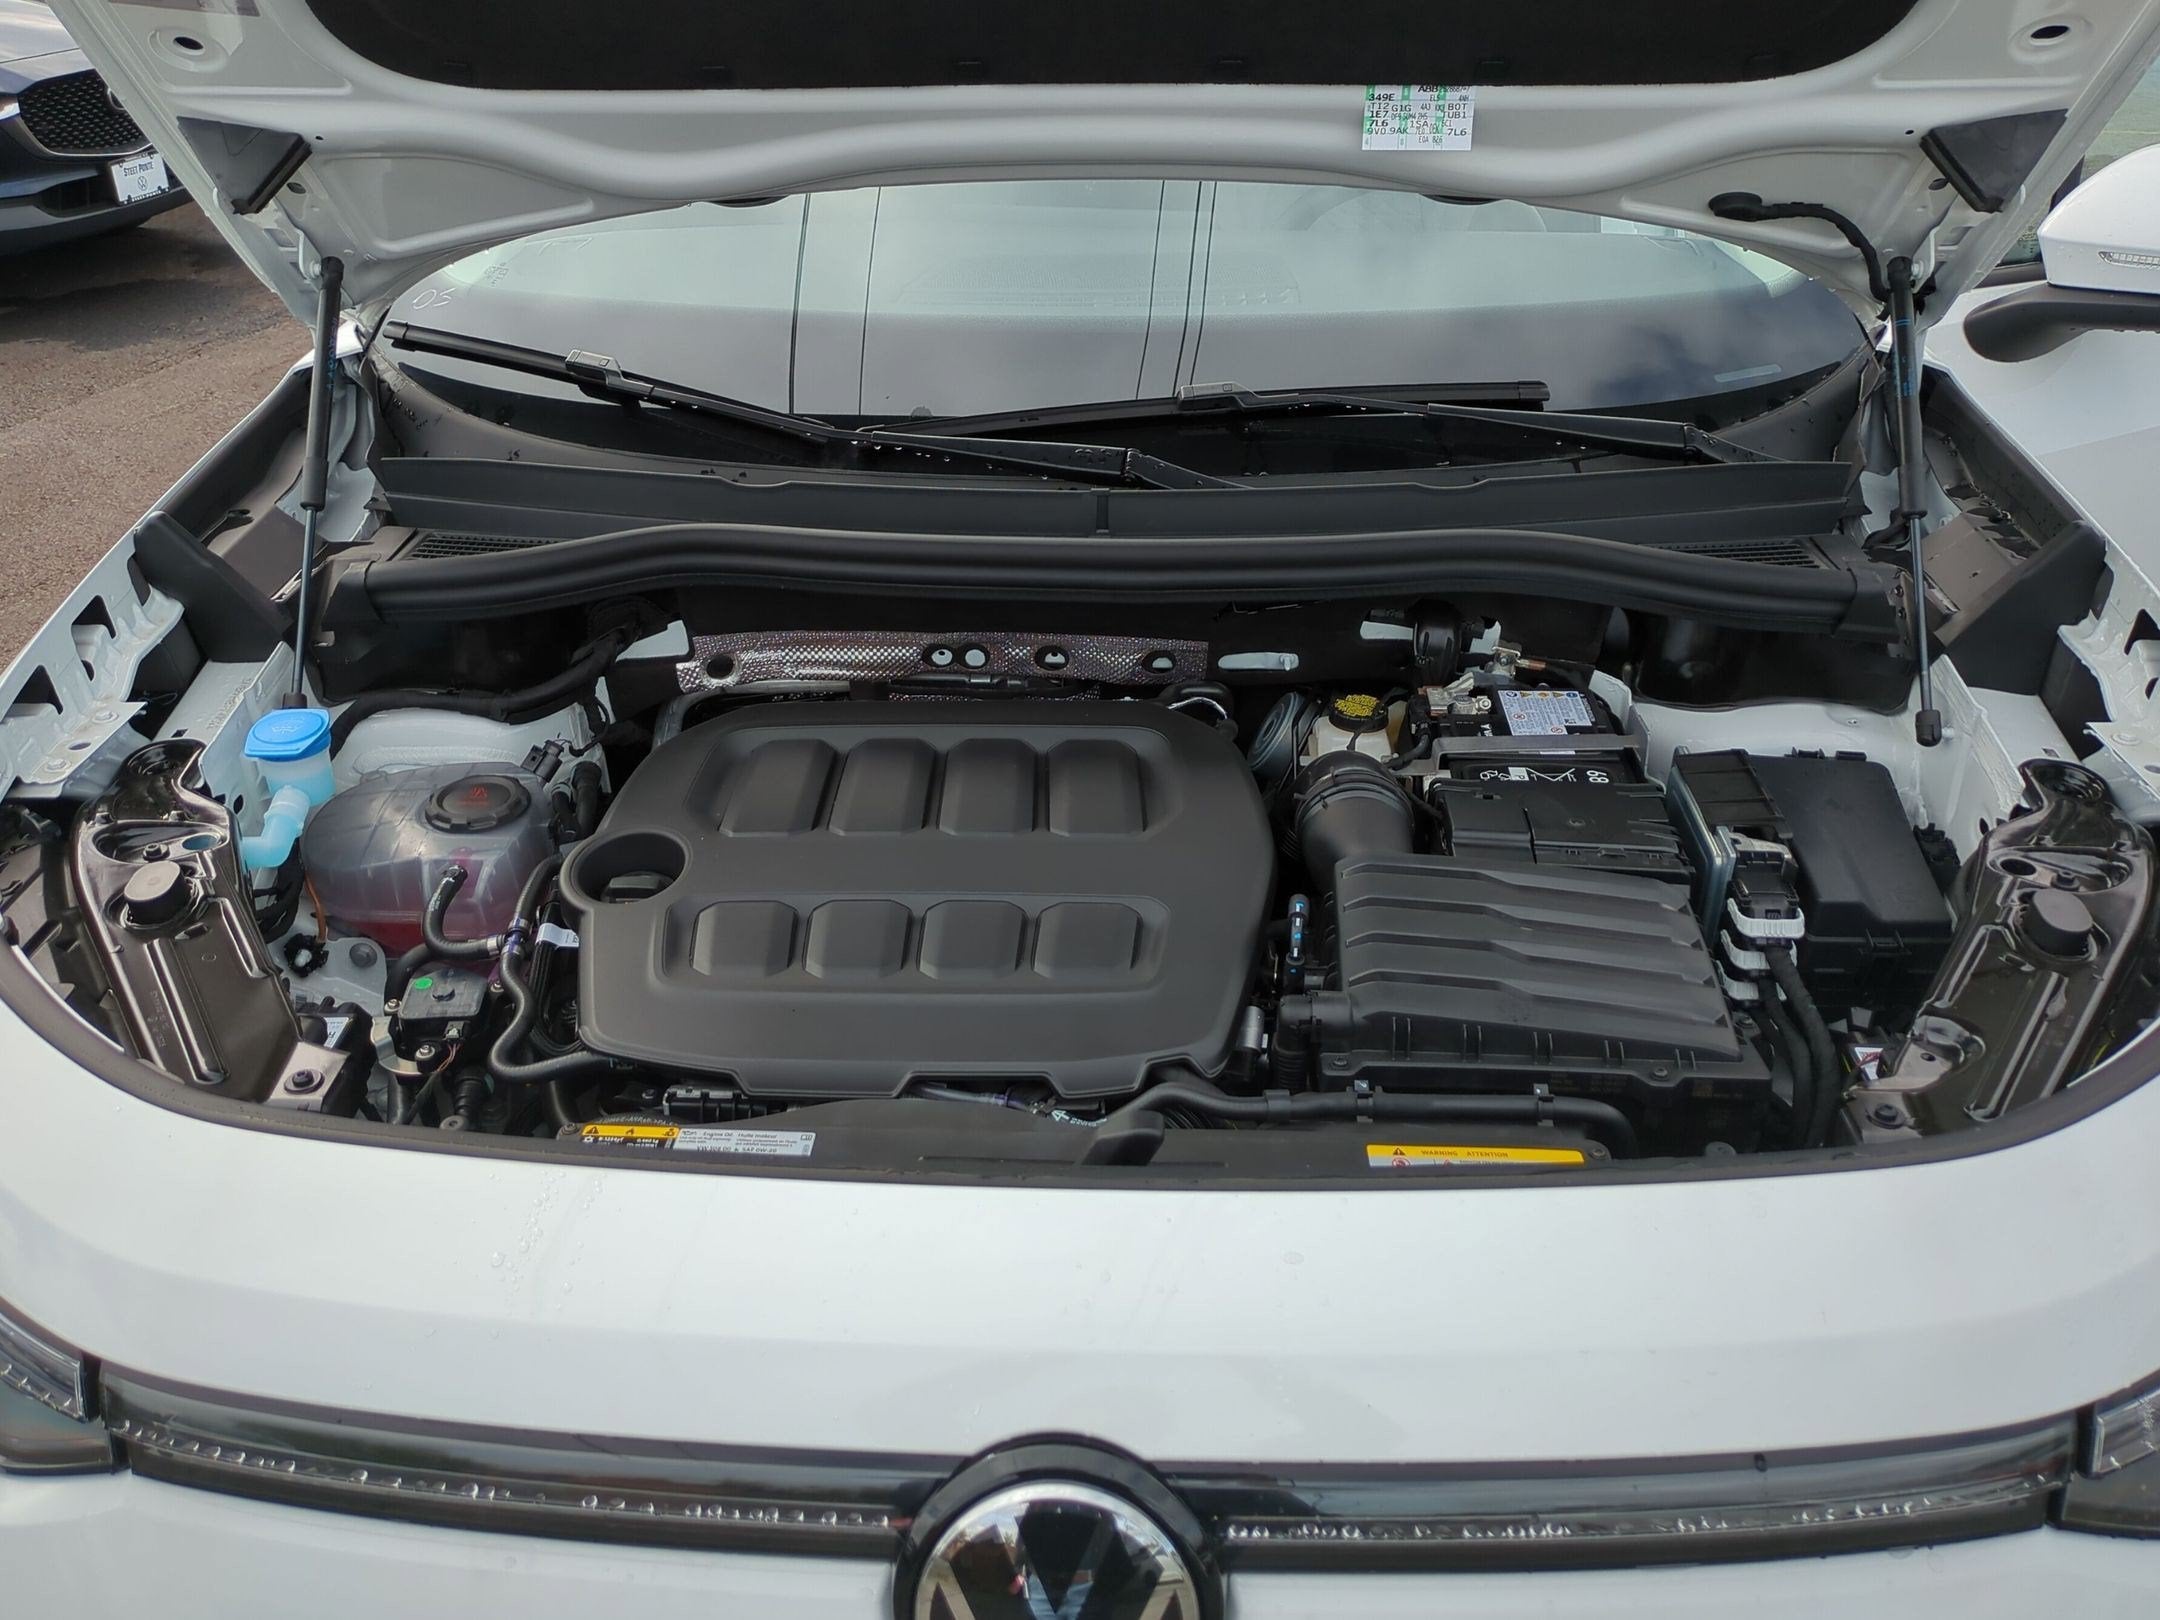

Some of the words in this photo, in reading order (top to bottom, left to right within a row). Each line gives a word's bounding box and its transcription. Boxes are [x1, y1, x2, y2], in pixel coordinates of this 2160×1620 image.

[1368, 93, 1395, 101] 349E
[1369, 119, 1389, 127] 7L6
[1447, 128, 1467, 136] 7L6
